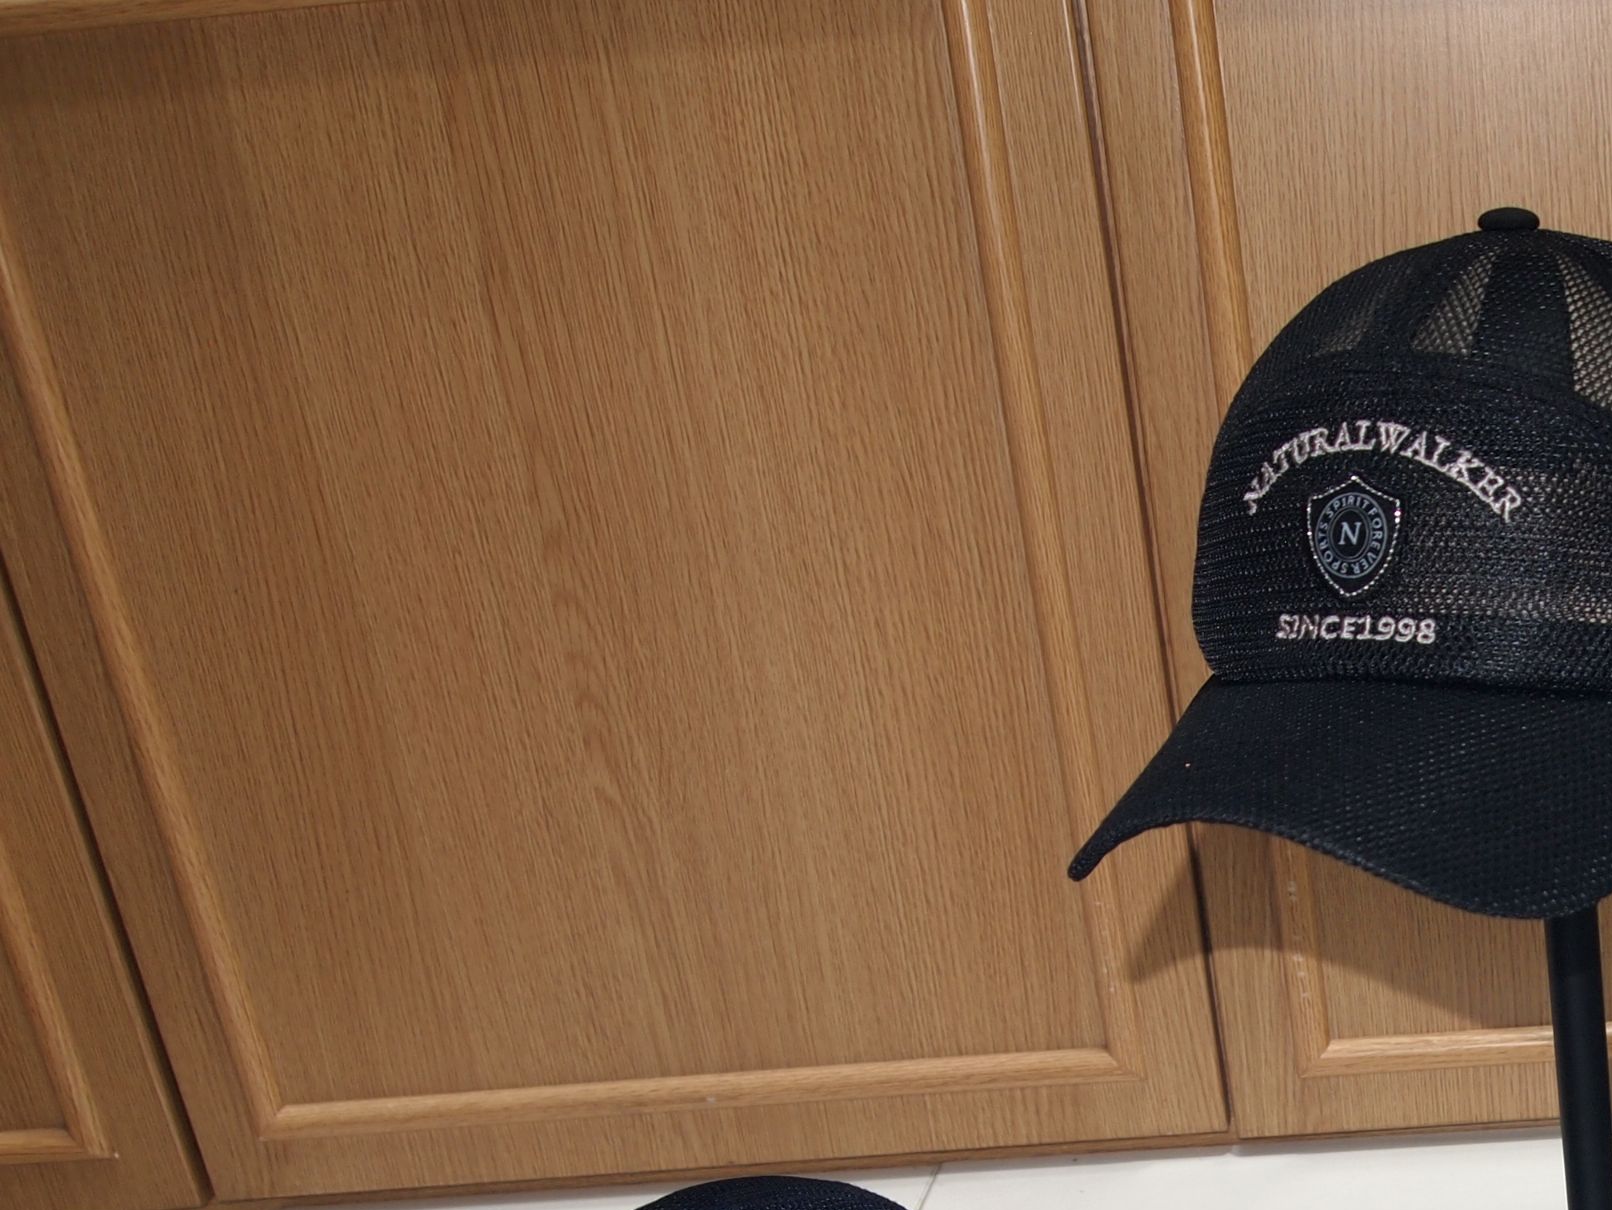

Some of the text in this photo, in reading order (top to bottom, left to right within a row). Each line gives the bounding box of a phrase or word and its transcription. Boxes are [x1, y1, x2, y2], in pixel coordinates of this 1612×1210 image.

[1243, 420, 1521, 522] NATURALWALKER
[1318, 495, 1383, 574] SPORTS SPIRIT FOREVER
[1338, 522, 1362, 545] N
[1276, 613, 1436, 644] SINCE1998
